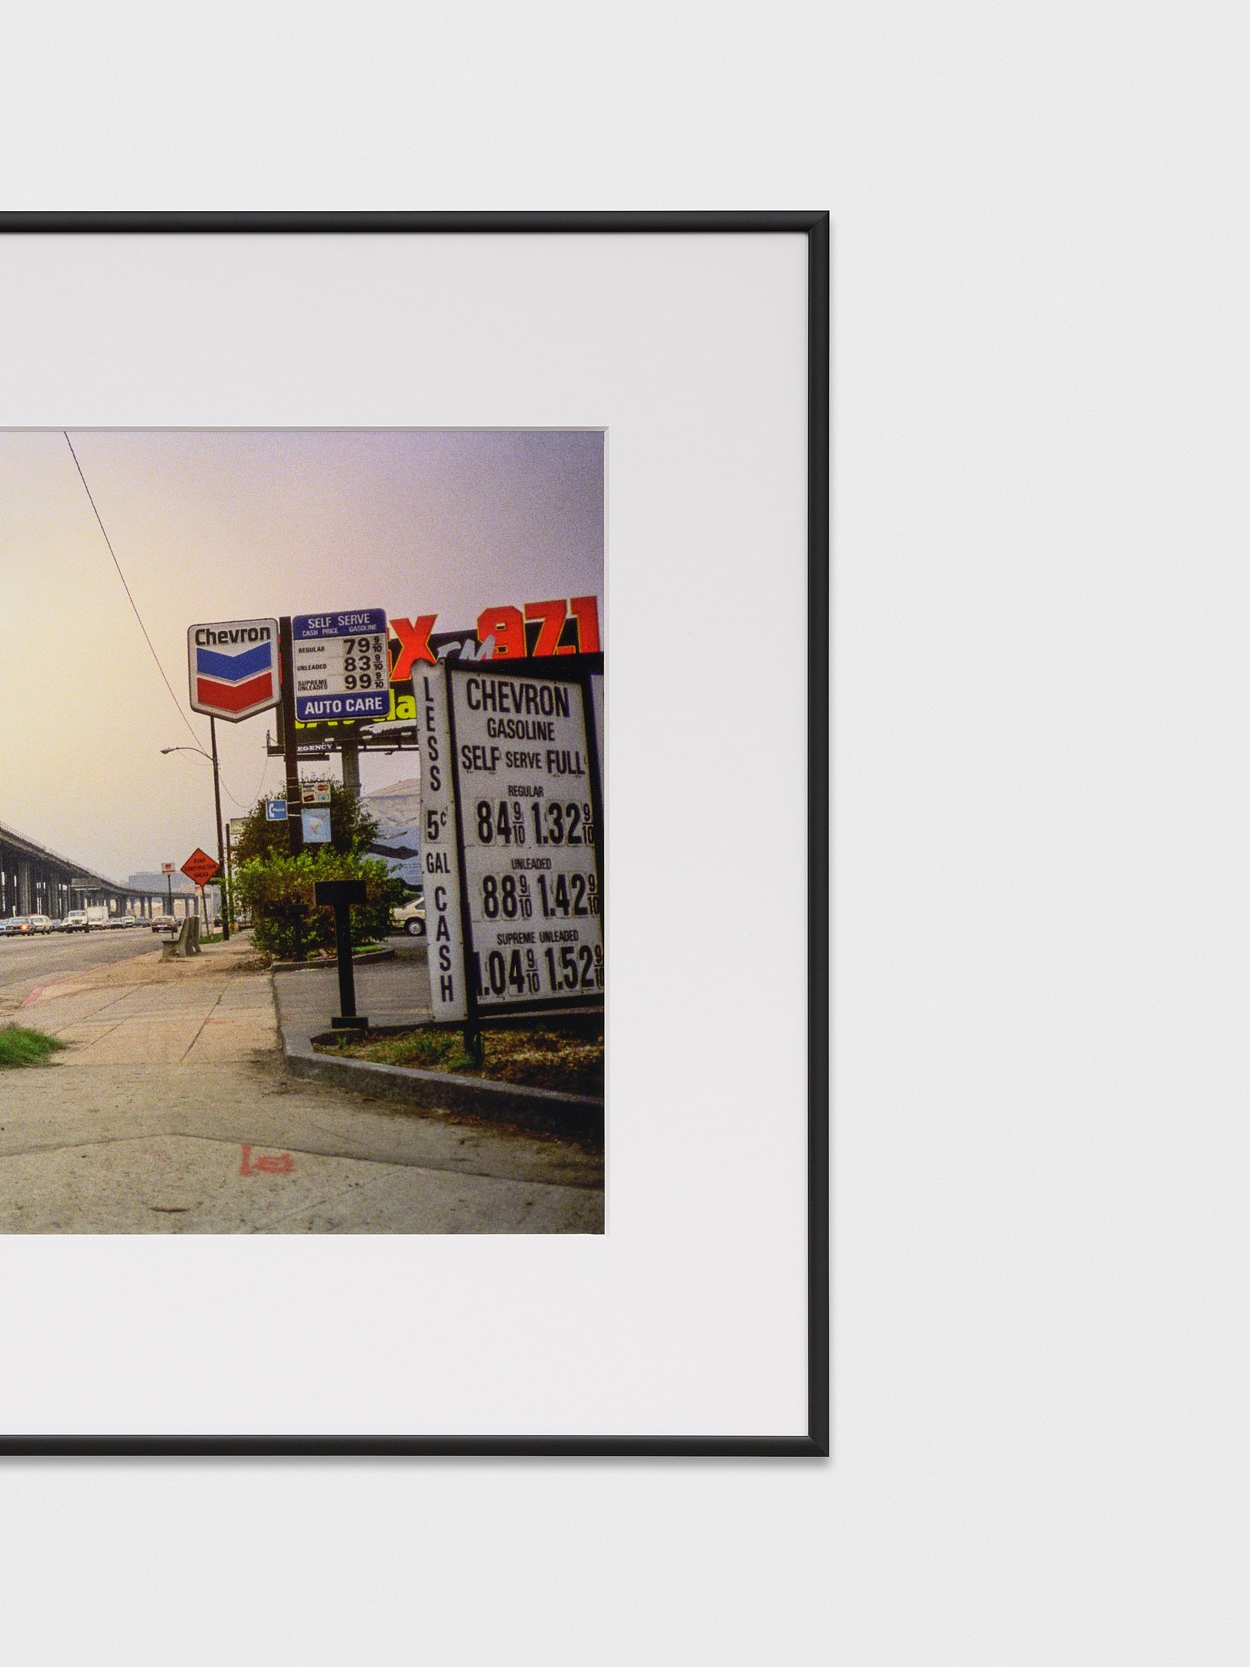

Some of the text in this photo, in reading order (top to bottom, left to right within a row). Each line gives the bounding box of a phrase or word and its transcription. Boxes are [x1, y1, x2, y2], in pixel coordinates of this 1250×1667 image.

[308, 613, 370, 629] SELF SERVE
[349, 624, 377, 632] GASOLINE
[195, 627, 270, 646] Chevron
[343, 638, 370, 655] 79
[344, 656, 371, 672] 83
[344, 674, 372, 690] 99
[305, 700, 342, 715] AUTO
[345, 697, 383, 712] CARE
[466, 678, 570, 717] CHEVRON
[487, 718, 555, 741] GASOLINE
[296, 744, 333, 752] EGENCY
[461, 745, 585, 774] SELF SERVE FULL
[508, 785, 544, 797] REGULAR
[477, 801, 511, 844] 84
[531, 802, 582, 844] 1.32
[426, 853, 451, 874] GAL
[511, 858, 551, 870] UNLEADED
[483, 875, 518, 918] 88
[537, 874, 588, 916] 1.42
[434, 886, 454, 1002] CASH
[497, 930, 579, 945] SUPREME UNLEADED
[545, 946, 595, 990] 1.52
